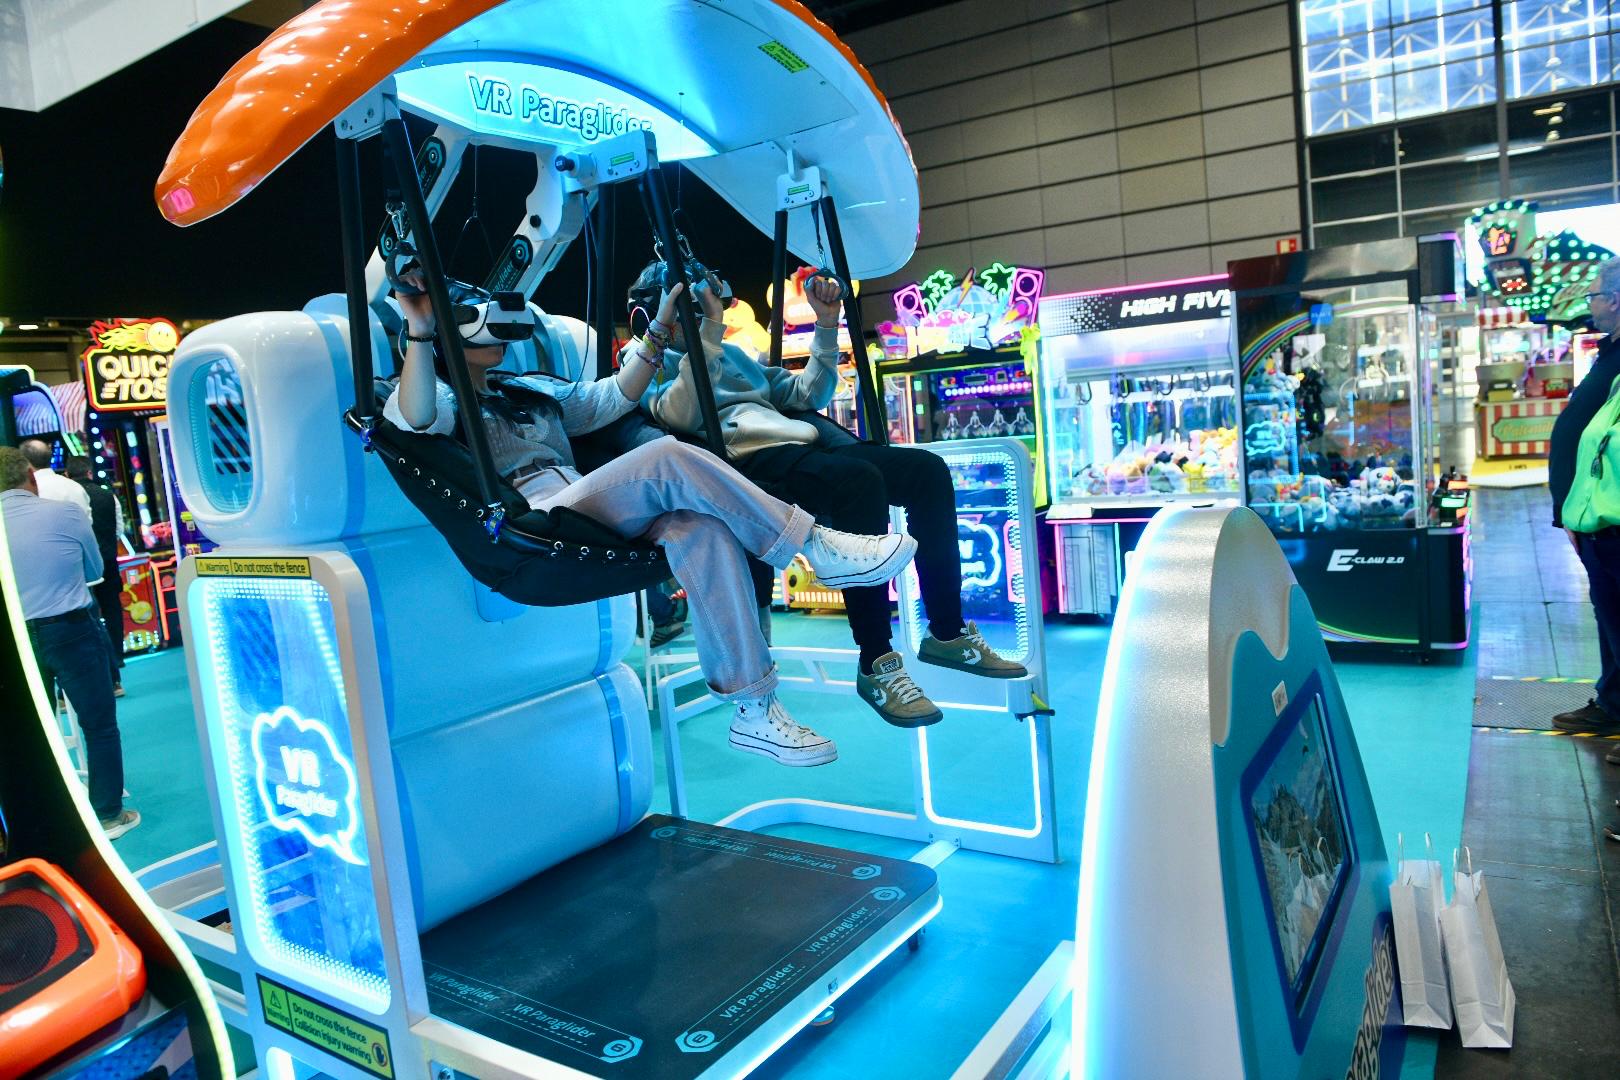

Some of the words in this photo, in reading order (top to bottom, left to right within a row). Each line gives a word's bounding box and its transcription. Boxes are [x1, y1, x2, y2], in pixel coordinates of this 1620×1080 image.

[468, 75, 512, 115] VR
[1120, 295, 1177, 318] HIGH
[116, 377, 168, 400] TOS
[206, 563, 229, 574] Warning
[234, 562, 243, 573] Do
[243, 563, 255, 573] not
[255, 565, 272, 573] cross
[273, 562, 285, 573] the
[285, 562, 306, 574] fence
[1326, 549, 1385, 571] E-CLAW
[1386, 556, 1405, 564] 2.0
[805, 940, 824, 953] VR
[820, 906, 869, 943] Paraglider
[428, 971, 444, 981] VR
[444, 977, 500, 1002] Paraglider
[719, 1003, 740, 1020] VR
[739, 961, 796, 1008] Paraglider
[266, 1007, 291, 1026] Warning
[292, 1002, 303, 1015] Do
[303, 1008, 315, 1020] not
[315, 1014, 334, 1029] cross
[333, 1020, 346, 1035] the
[512, 1003, 533, 1016] VR
[529, 1009, 596, 1039] Paraglider
[293, 1018, 322, 1039] Collision
[321, 1029, 342, 1050] injury
[341, 1039, 372, 1064] warning
